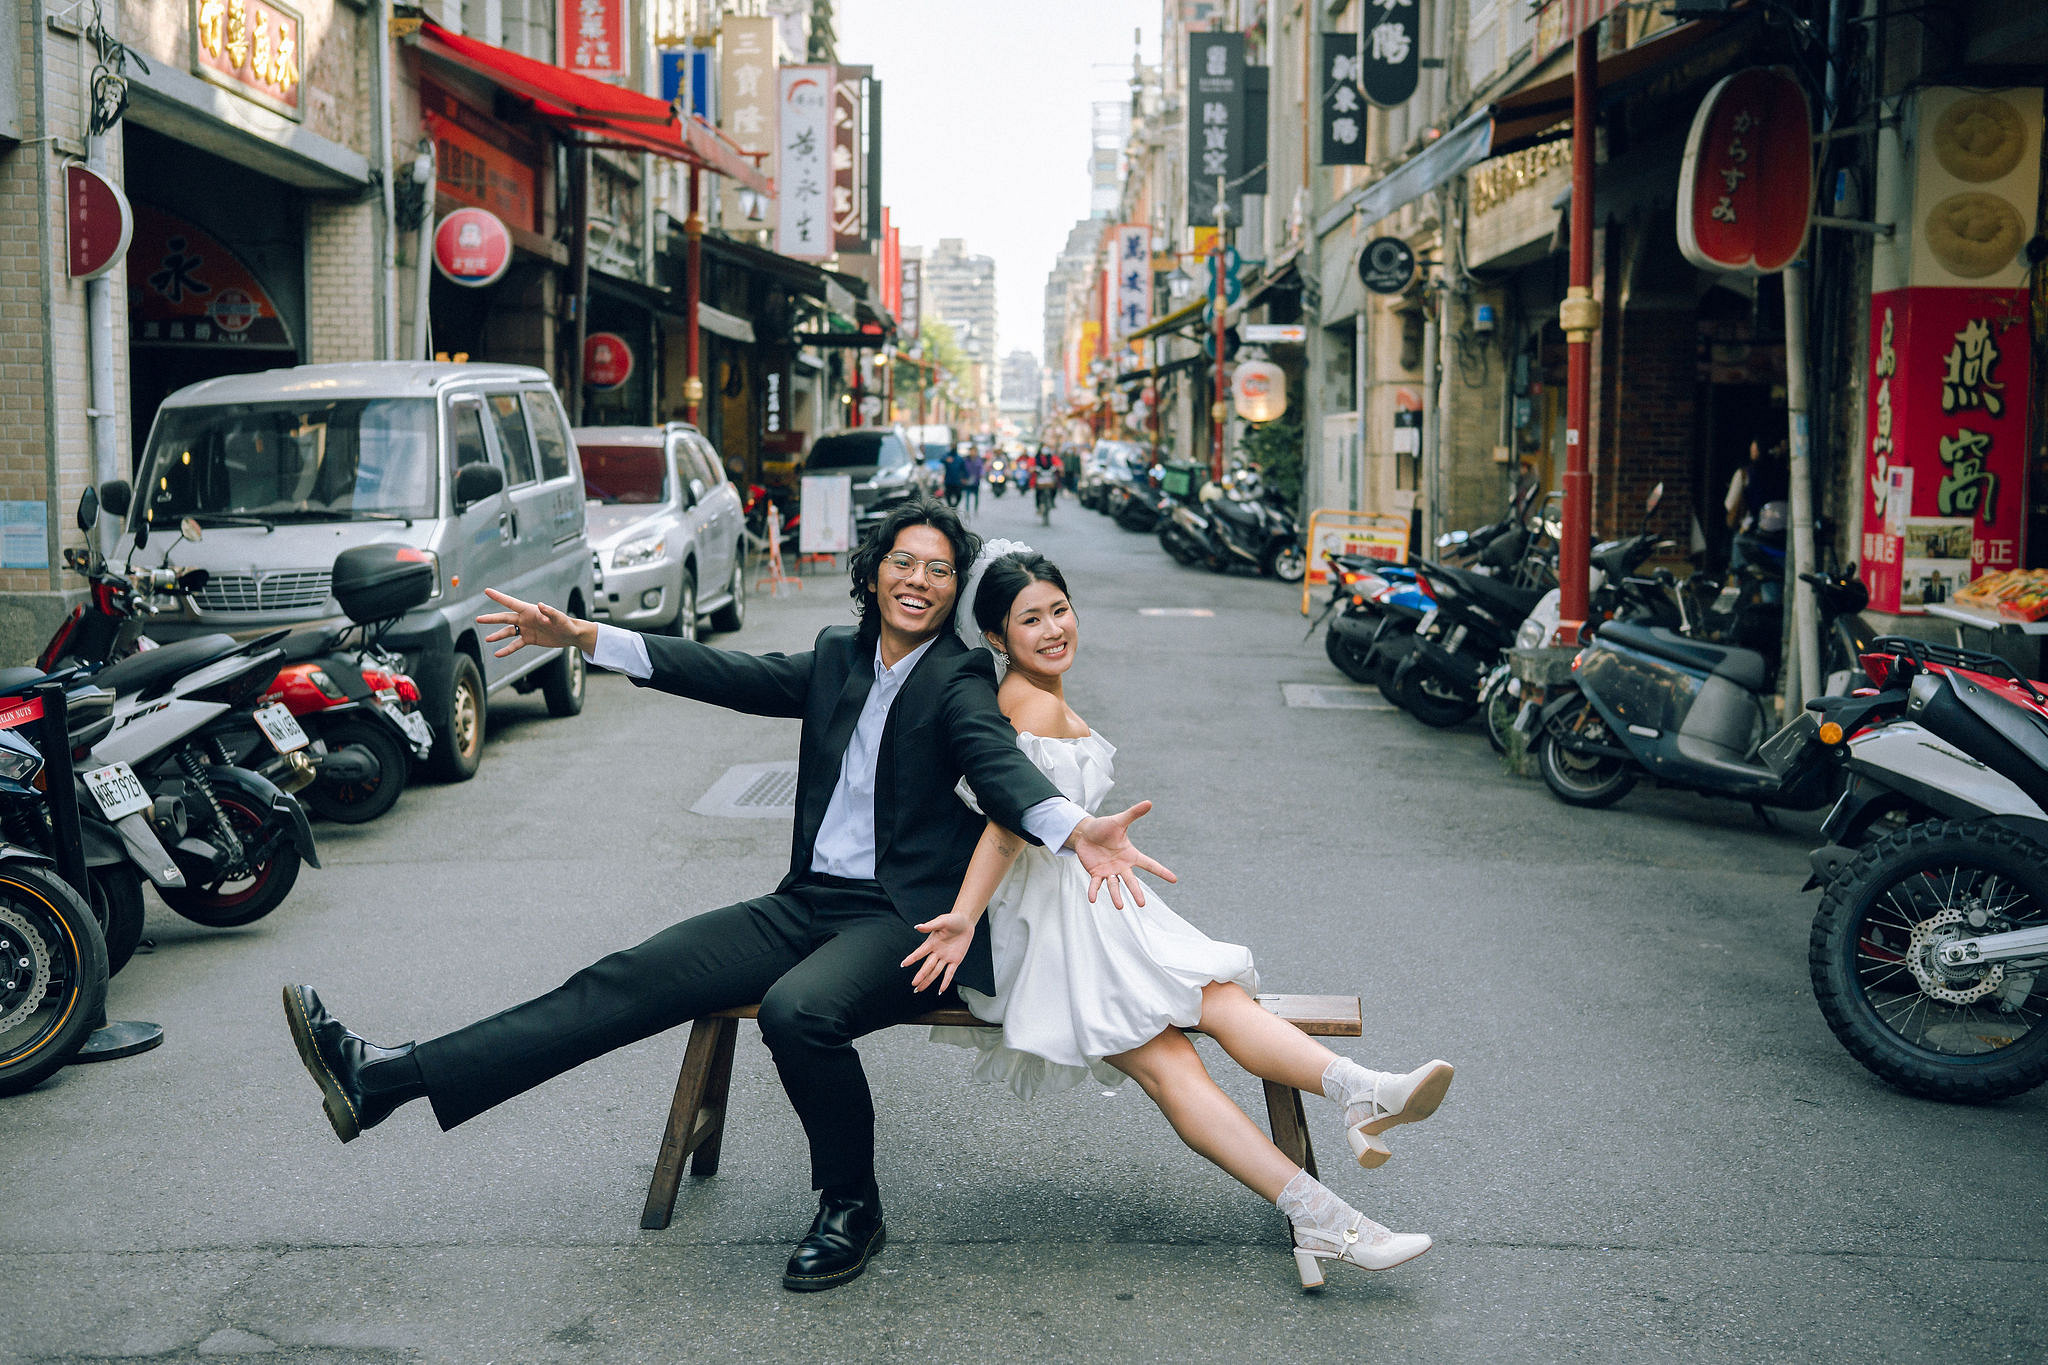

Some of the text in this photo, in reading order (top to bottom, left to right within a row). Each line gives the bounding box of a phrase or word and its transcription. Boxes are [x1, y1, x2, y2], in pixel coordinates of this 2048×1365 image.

[733, 32, 764, 156] 三寶隆
[1712, 110, 1760, 224] からすみ
[15, 705, 32, 718] NUTS
